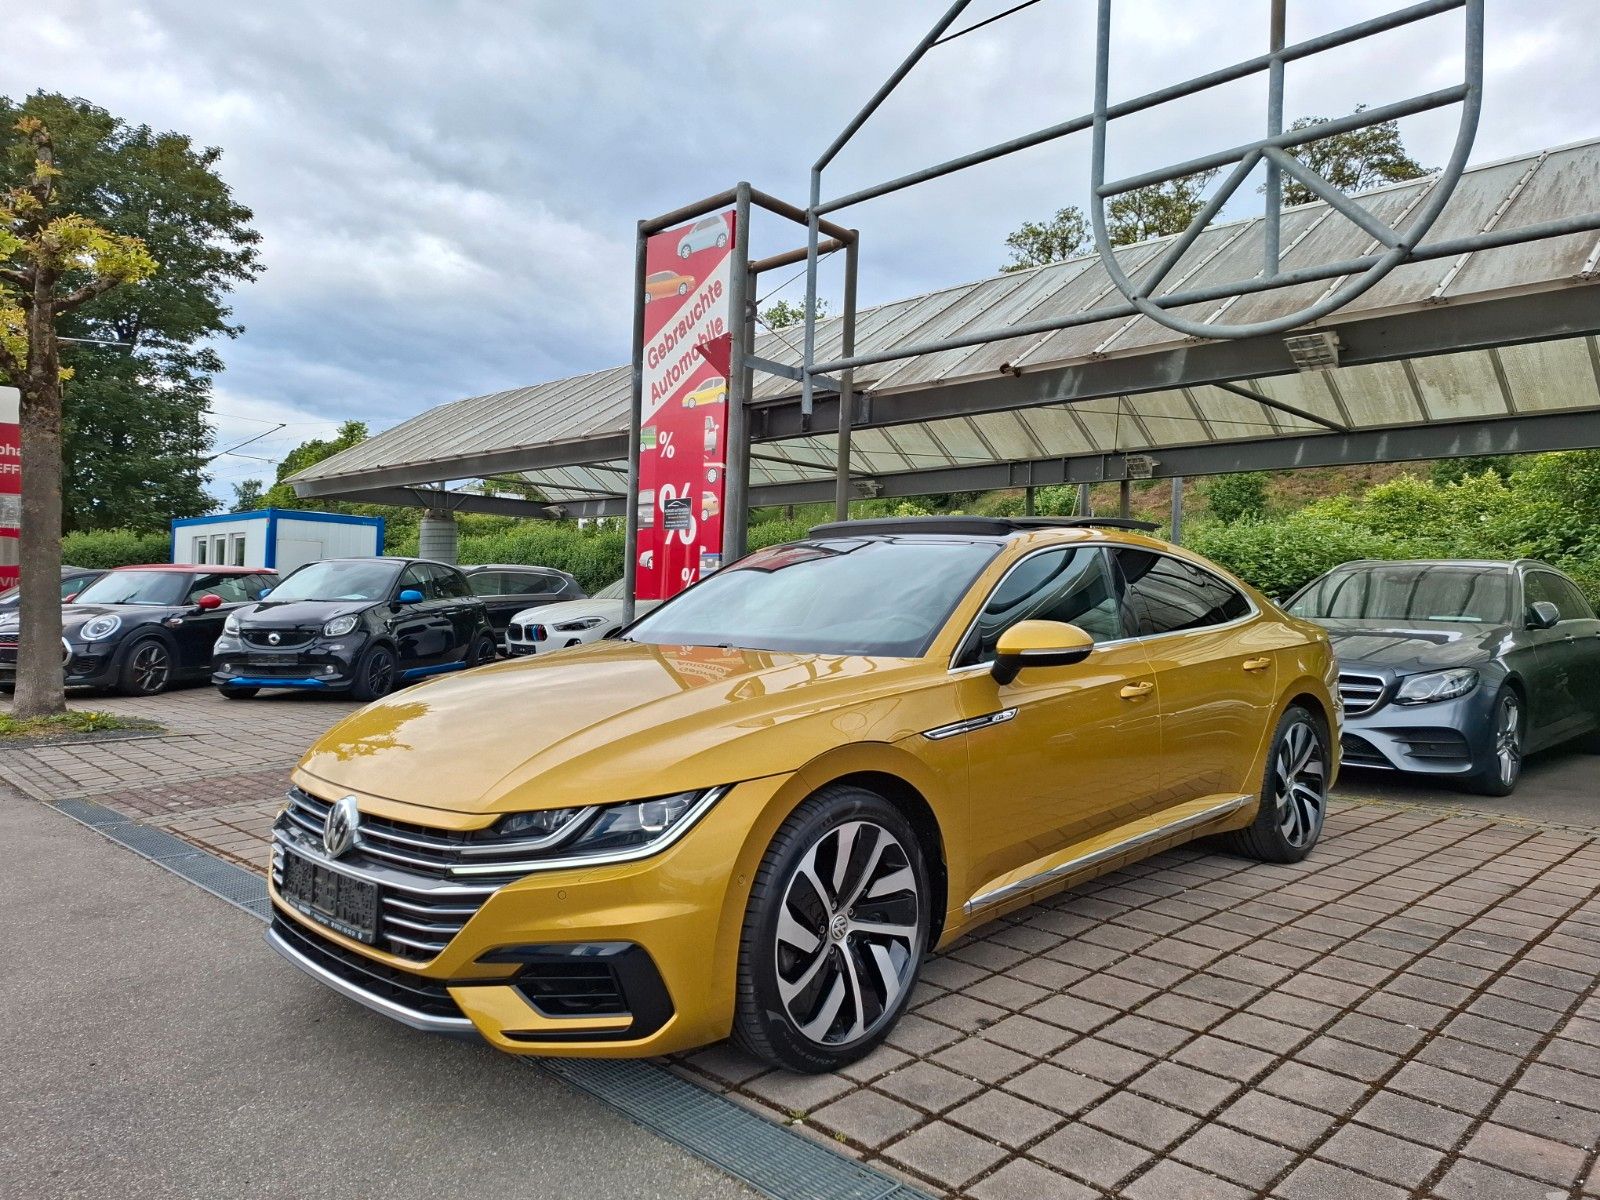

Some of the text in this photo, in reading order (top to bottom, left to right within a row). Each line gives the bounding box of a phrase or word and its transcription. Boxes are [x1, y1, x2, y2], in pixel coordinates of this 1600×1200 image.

[647, 279, 723, 370] Gebrauchte
[650, 316, 724, 406] Automobile
[659, 431, 675, 458] %
